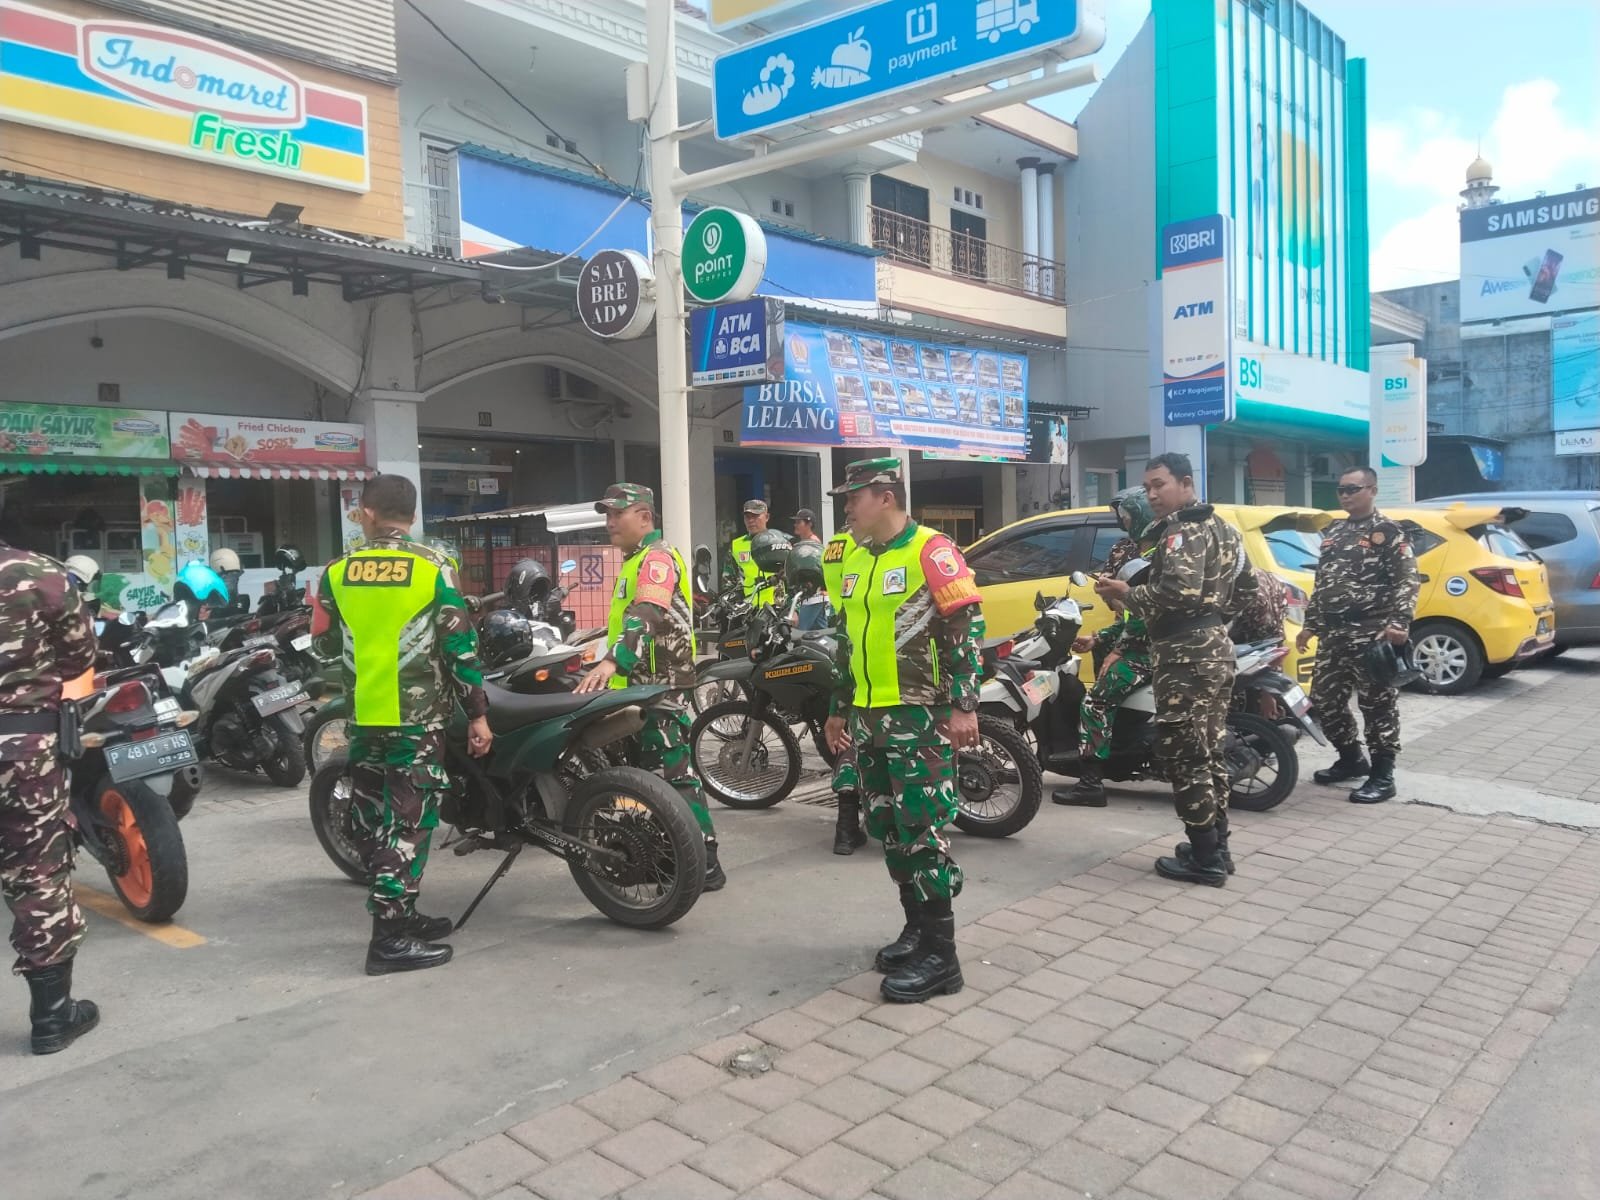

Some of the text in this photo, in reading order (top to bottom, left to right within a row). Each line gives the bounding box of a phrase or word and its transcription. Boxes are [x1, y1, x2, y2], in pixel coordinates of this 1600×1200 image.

[888, 36, 957, 73] payment
[97, 38, 289, 113] Indomaret
[191, 113, 300, 167] Fresh
[1488, 197, 1600, 232] SAMSUNG
[1187, 229, 1215, 250] BRI
[591, 260, 627, 283] SAY
[591, 282, 627, 304] BRE
[592, 306, 616, 324] AD
[1173, 301, 1214, 320] ATM
[718, 313, 752, 336] ATM
[730, 336, 760, 356] BCA
[1239, 357, 1262, 389] BSI
[1384, 377, 1408, 391] BSI
[758, 380, 826, 403] BURSA
[40, 415, 95, 435] SAYUR
[747, 406, 835, 430] LELANG
[1173, 411, 1196, 419] Money
[238, 422, 306, 434] Fried Chicken
[347, 561, 408, 582] 0825
[127, 585, 155, 600] SAYUR
[110, 736, 187, 764] P 4813 HS
